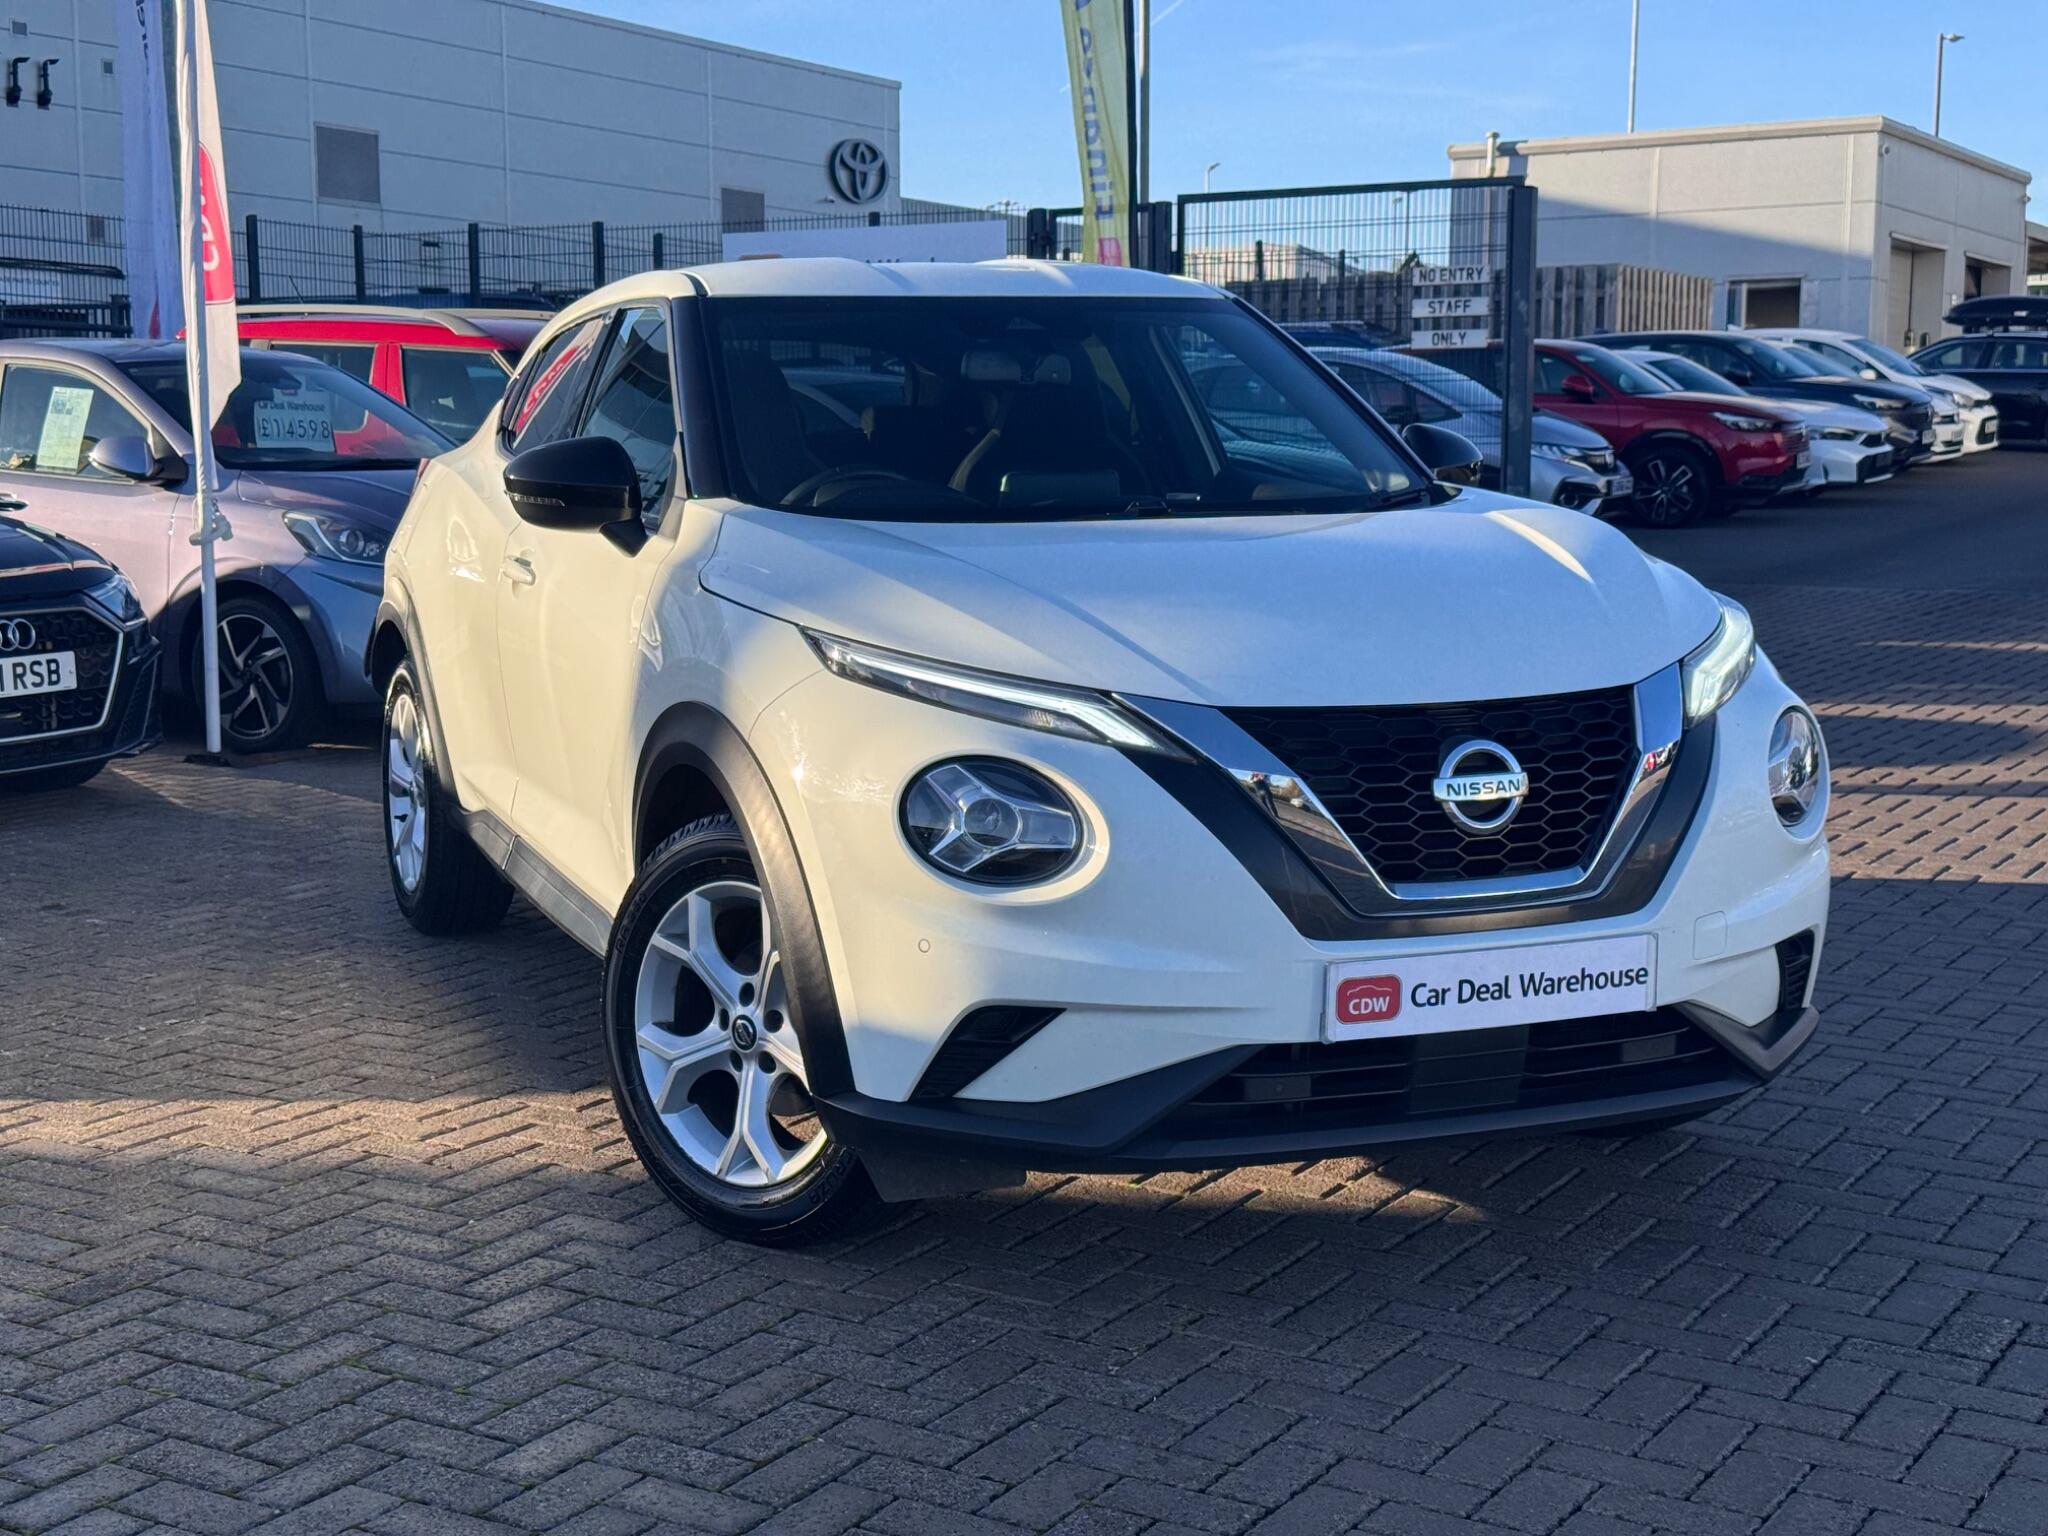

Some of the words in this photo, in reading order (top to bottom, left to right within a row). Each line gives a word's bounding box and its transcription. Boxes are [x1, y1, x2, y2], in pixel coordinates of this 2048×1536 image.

[1419, 268, 1436, 283] NO
[1440, 266, 1484, 281] ENTRY
[1427, 299, 1472, 315] STAFF
[1431, 332, 1467, 347] ONLY
[261, 418, 330, 439] £14598
[12, 658, 61, 691] RSB
[1446, 779, 1520, 797] NISSAN
[1411, 982, 1451, 1008] Car
[1457, 974, 1512, 1005] Deal
[1519, 966, 1649, 999] Warehouse
[1348, 996, 1391, 1016] CDW
